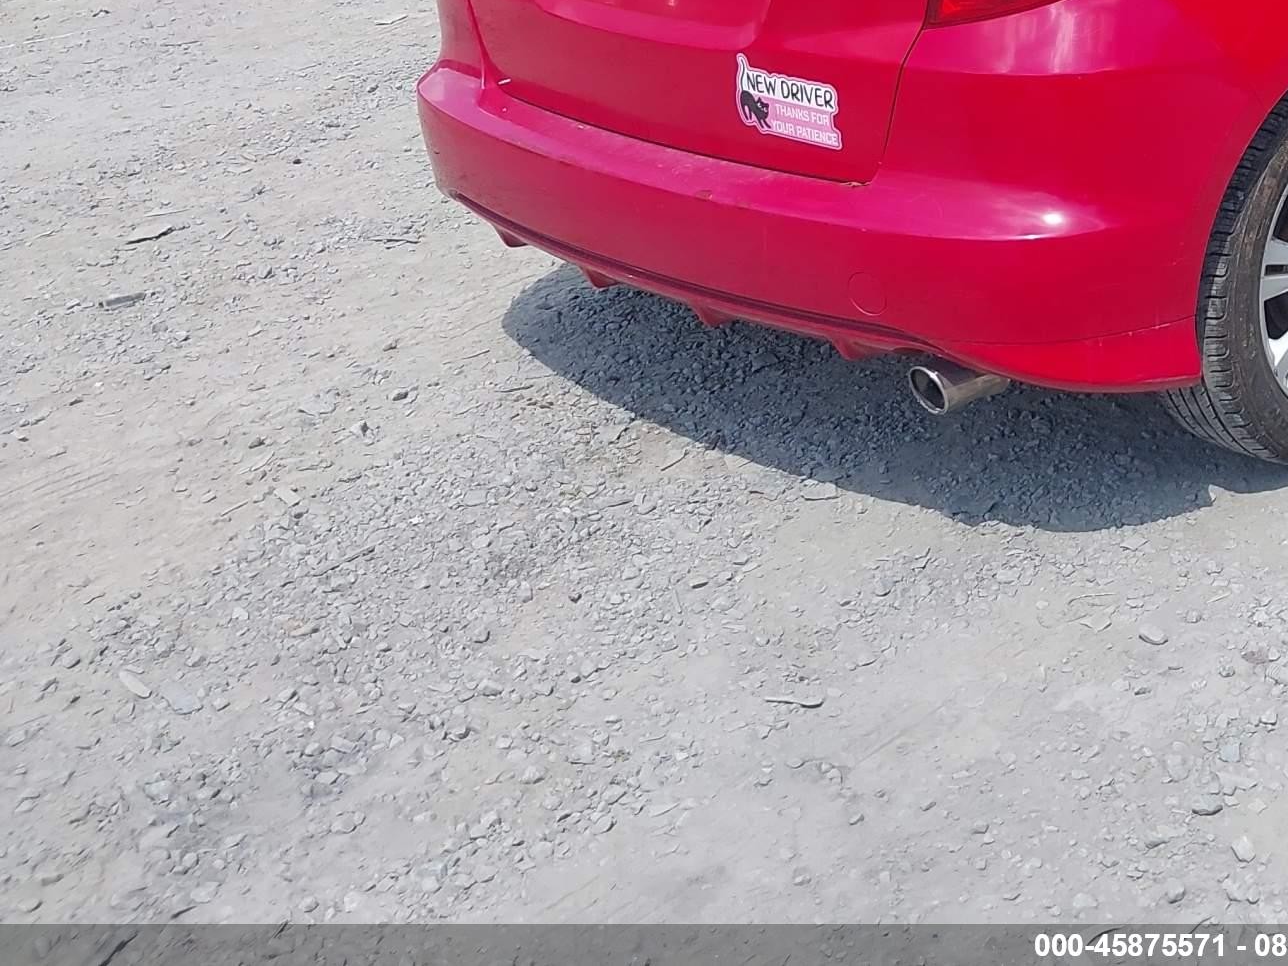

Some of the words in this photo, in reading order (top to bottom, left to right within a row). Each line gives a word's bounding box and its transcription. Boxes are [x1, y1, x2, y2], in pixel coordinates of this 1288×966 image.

[746, 72, 777, 95] NEW
[780, 80, 834, 109] DRIVER
[776, 105, 809, 121] THANKS
[811, 113, 830, 127] FOR
[771, 121, 796, 135] YOUR
[796, 127, 838, 145] PATIENCE
